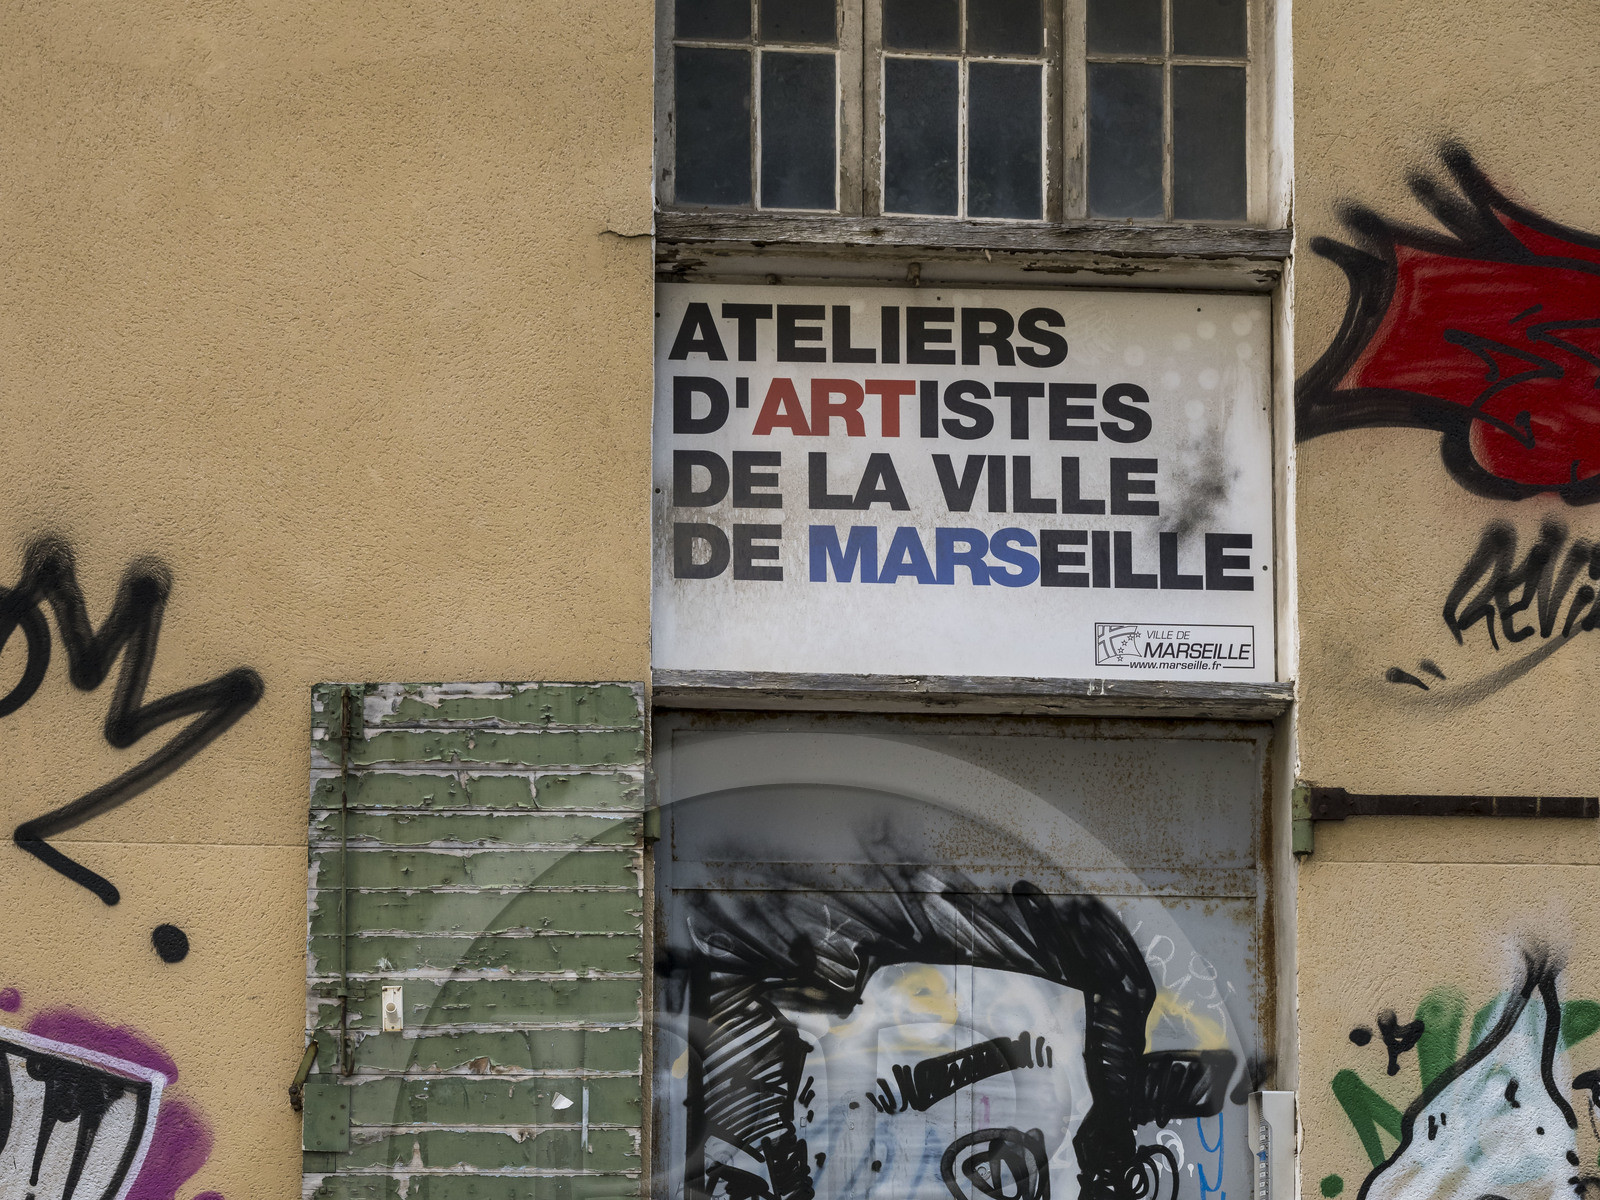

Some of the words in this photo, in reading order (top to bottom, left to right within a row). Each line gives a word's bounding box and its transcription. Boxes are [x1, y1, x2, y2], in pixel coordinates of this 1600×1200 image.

[668, 302, 1069, 369] ATELIERS
[672, 375, 1153, 444] D'ARTISTES
[672, 449, 783, 509] DE
[808, 451, 911, 512] LA
[931, 453, 1161, 517] VILLE
[672, 522, 784, 582] DE
[808, 524, 1256, 593] MARSEILLE
[1129, 660, 1222, 671] www.marseille.fr
[1143, 641, 1252, 660] MARSEILLE
[1146, 629, 1174, 640] VILLE
[1176, 630, 1191, 640] DE
